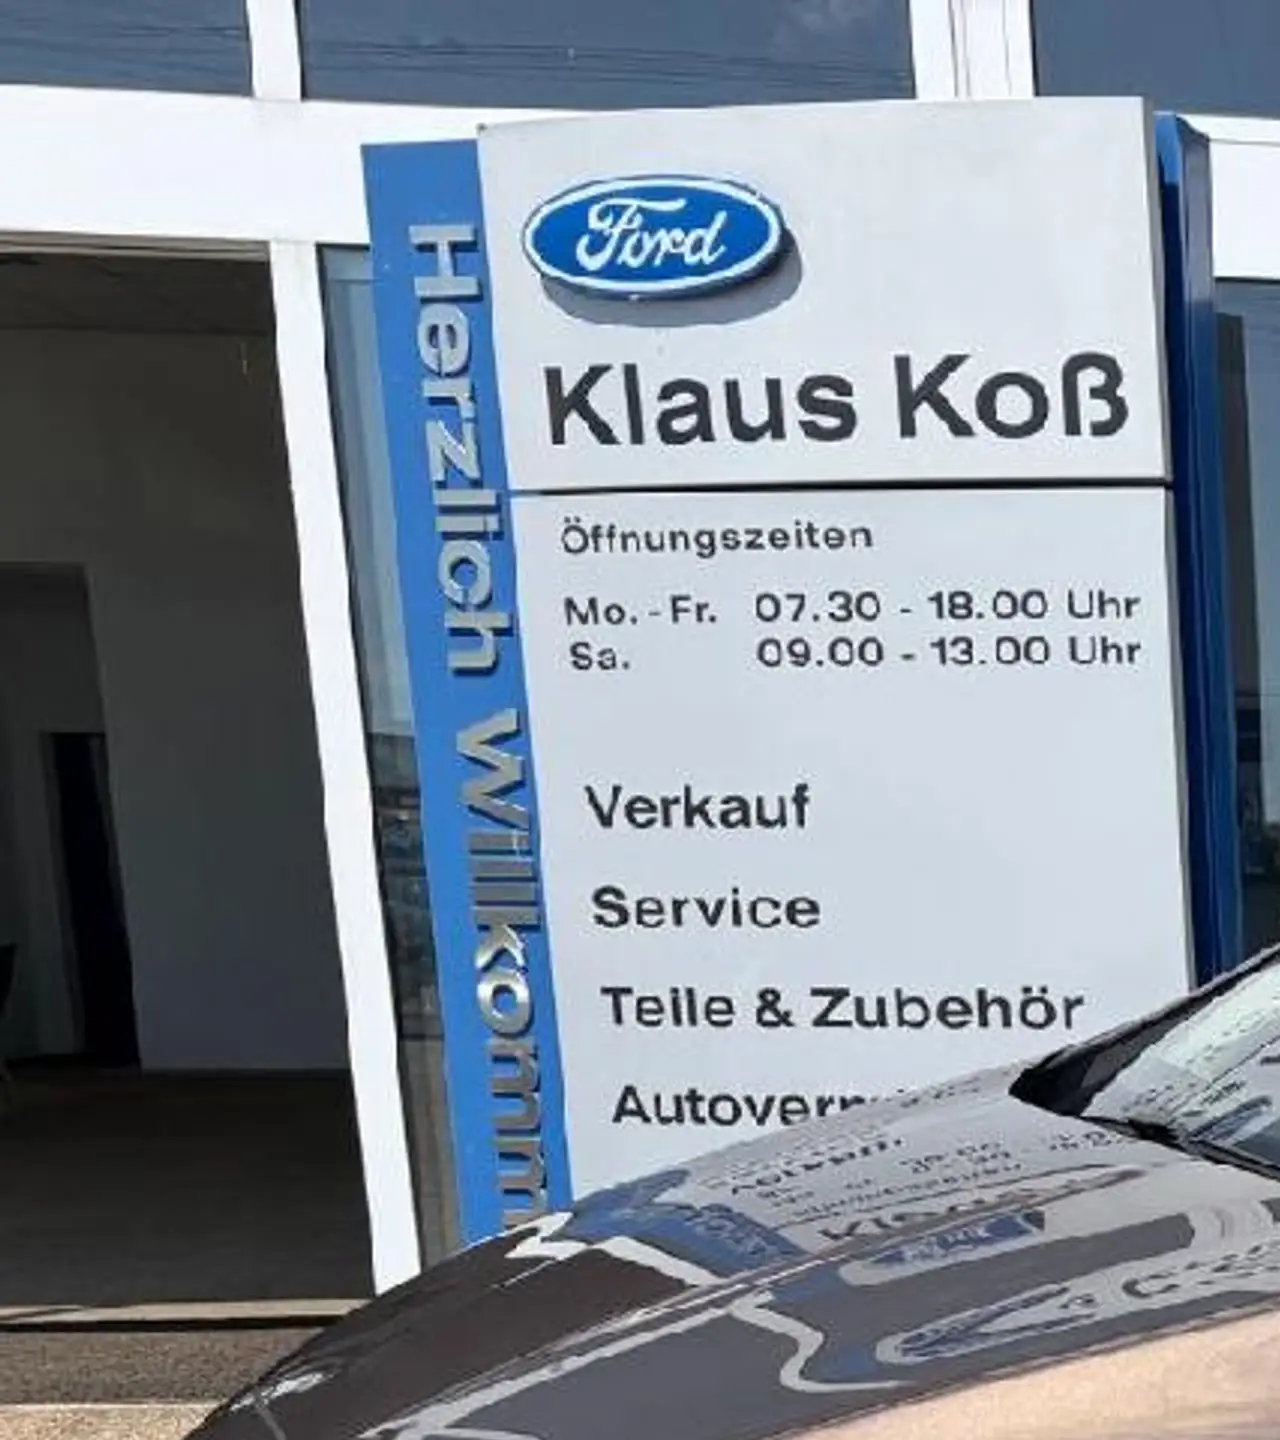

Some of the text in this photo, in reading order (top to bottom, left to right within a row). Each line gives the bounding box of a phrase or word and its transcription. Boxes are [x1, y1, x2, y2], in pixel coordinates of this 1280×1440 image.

[576, 198, 727, 271] Ford
[544, 351, 1129, 446] Klaus Koß
[408, 225, 513, 673] Herzlich
[560, 515, 873, 559] Öffnungszeiten
[755, 590, 881, 623] 07.30
[927, 589, 1049, 620] 18.00
[1067, 588, 1141, 620] Uhr
[568, 640, 631, 671] Sa.
[756, 636, 885, 668] 09.00
[930, 635, 1051, 666] 13.00
[1068, 635, 1141, 666] Uhr
[583, 783, 811, 830] Verkauf
[591, 884, 821, 929] Service
[599, 985, 1085, 1030] Teile & Zubehör
